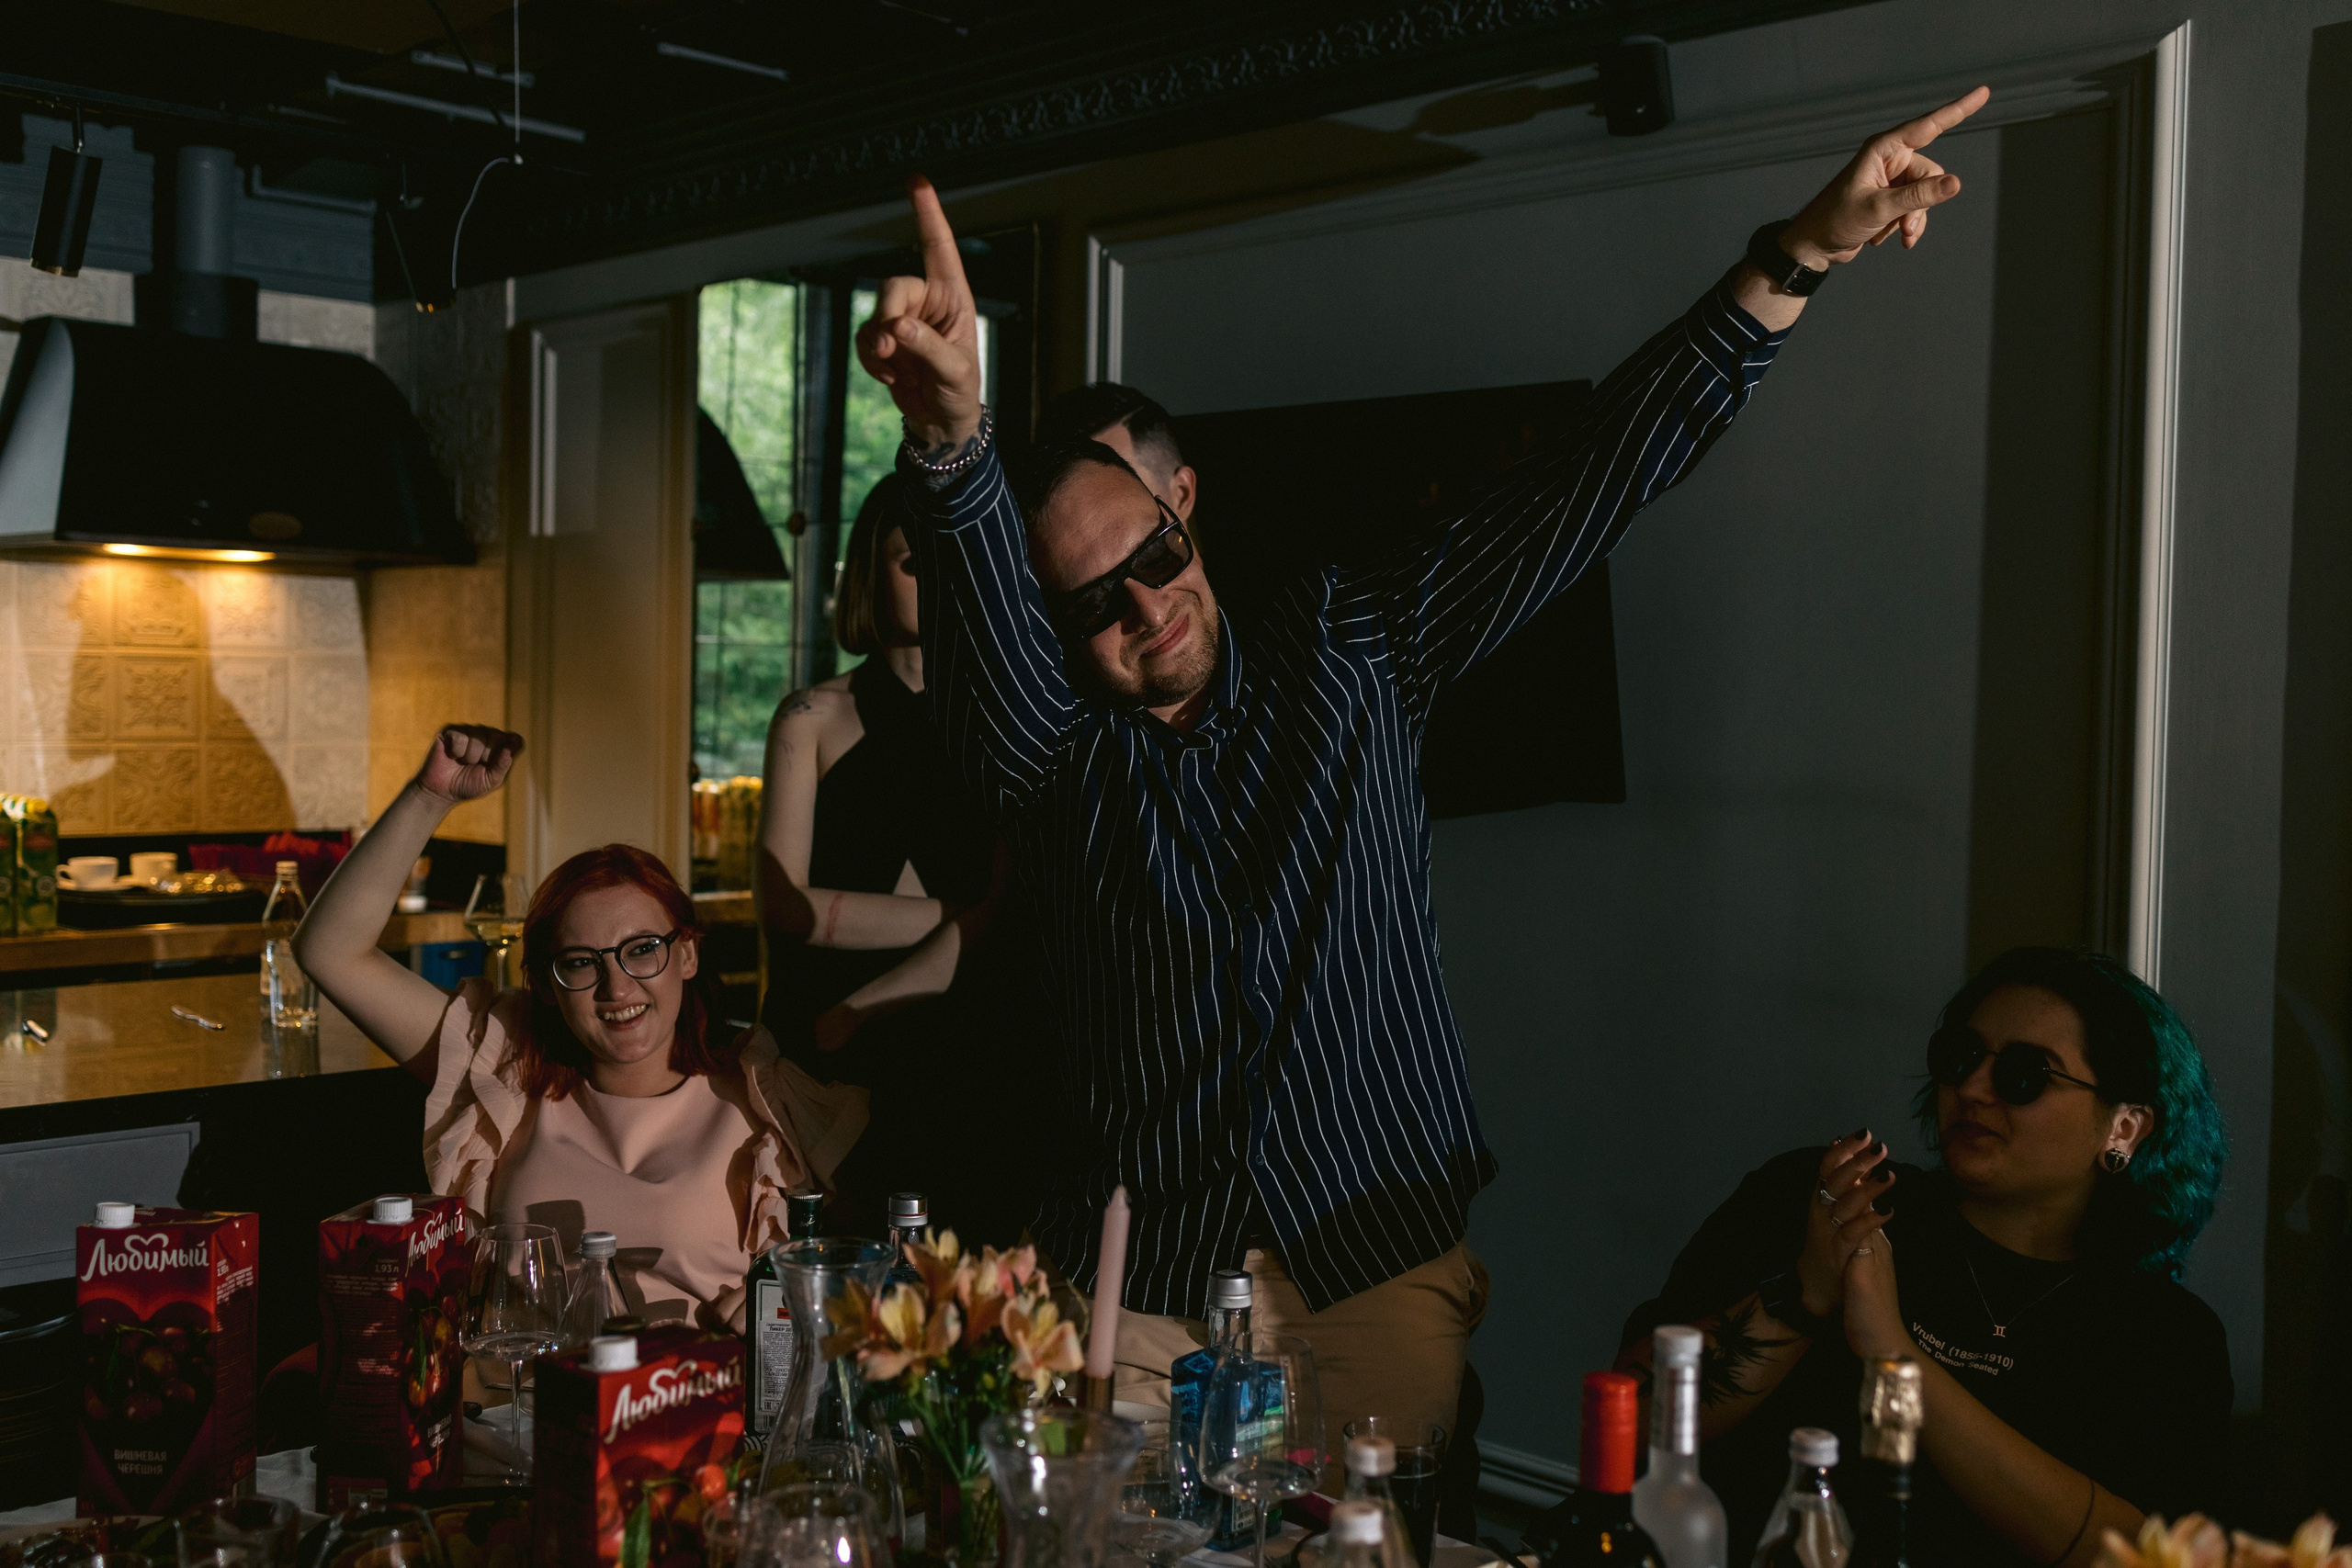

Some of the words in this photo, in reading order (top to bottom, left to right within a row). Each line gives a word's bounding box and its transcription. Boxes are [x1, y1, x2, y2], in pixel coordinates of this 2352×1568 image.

[80, 1232, 210, 1282] Любимый
[404, 1207, 465, 1278] Любимый
[1912, 1322, 1946, 1350] Vrubel
[1948, 1346, 2014, 1371] (1856-1910)
[1917, 1338, 1932, 1354] The
[1934, 1350, 1965, 1368] Demon
[1967, 1361, 1999, 1376] Seated
[603, 1354, 742, 1445] Любимый
[113, 1449, 167, 1462] ВИШНЕВАЯ
[117, 1461, 164, 1475] ЧЕРЕШНЯ
